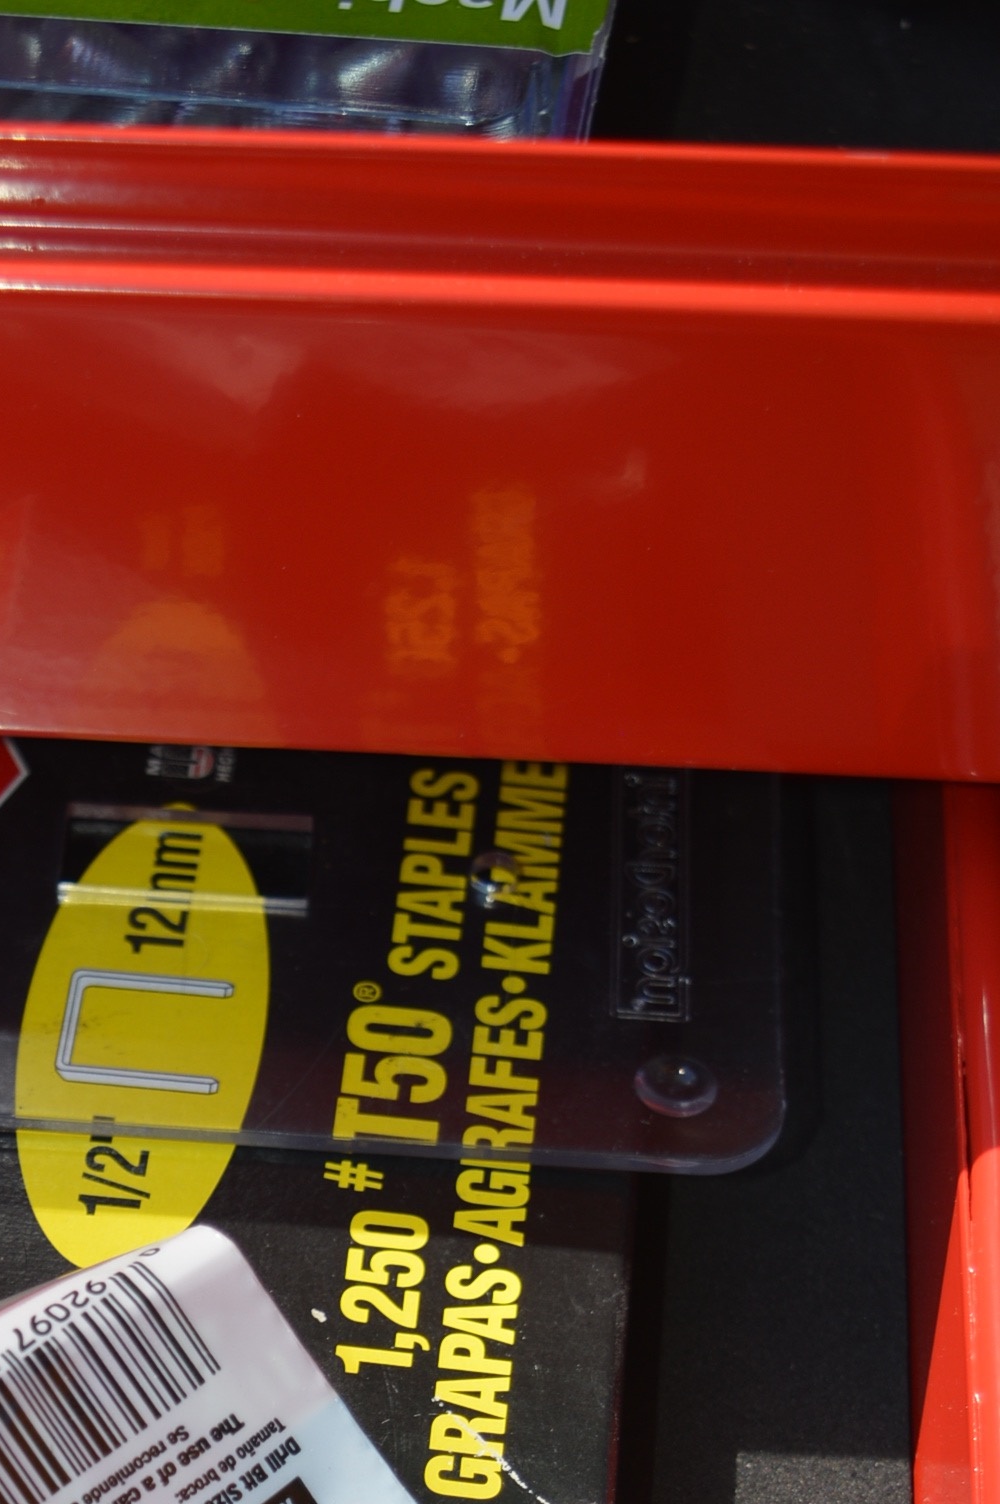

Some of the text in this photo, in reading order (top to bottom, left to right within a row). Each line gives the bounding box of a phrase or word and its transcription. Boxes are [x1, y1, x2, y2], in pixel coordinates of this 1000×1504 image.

[336, 1210, 430, 1372] 1,250
[387, 769, 480, 979] STAPLES
[10, 1265, 107, 1353] 92097
[165, 1424, 190, 1446] Se
[208, 1412, 245, 1444] The
[233, 1416, 286, 1461] Tamaño
[175, 1435, 212, 1467] use
[216, 1453, 238, 1474] de
[263, 1435, 302, 1473] Drill
[140, 1474, 157, 1493] a
[154, 1460, 179, 1487] of
[238, 1462, 269, 1492] Bit
